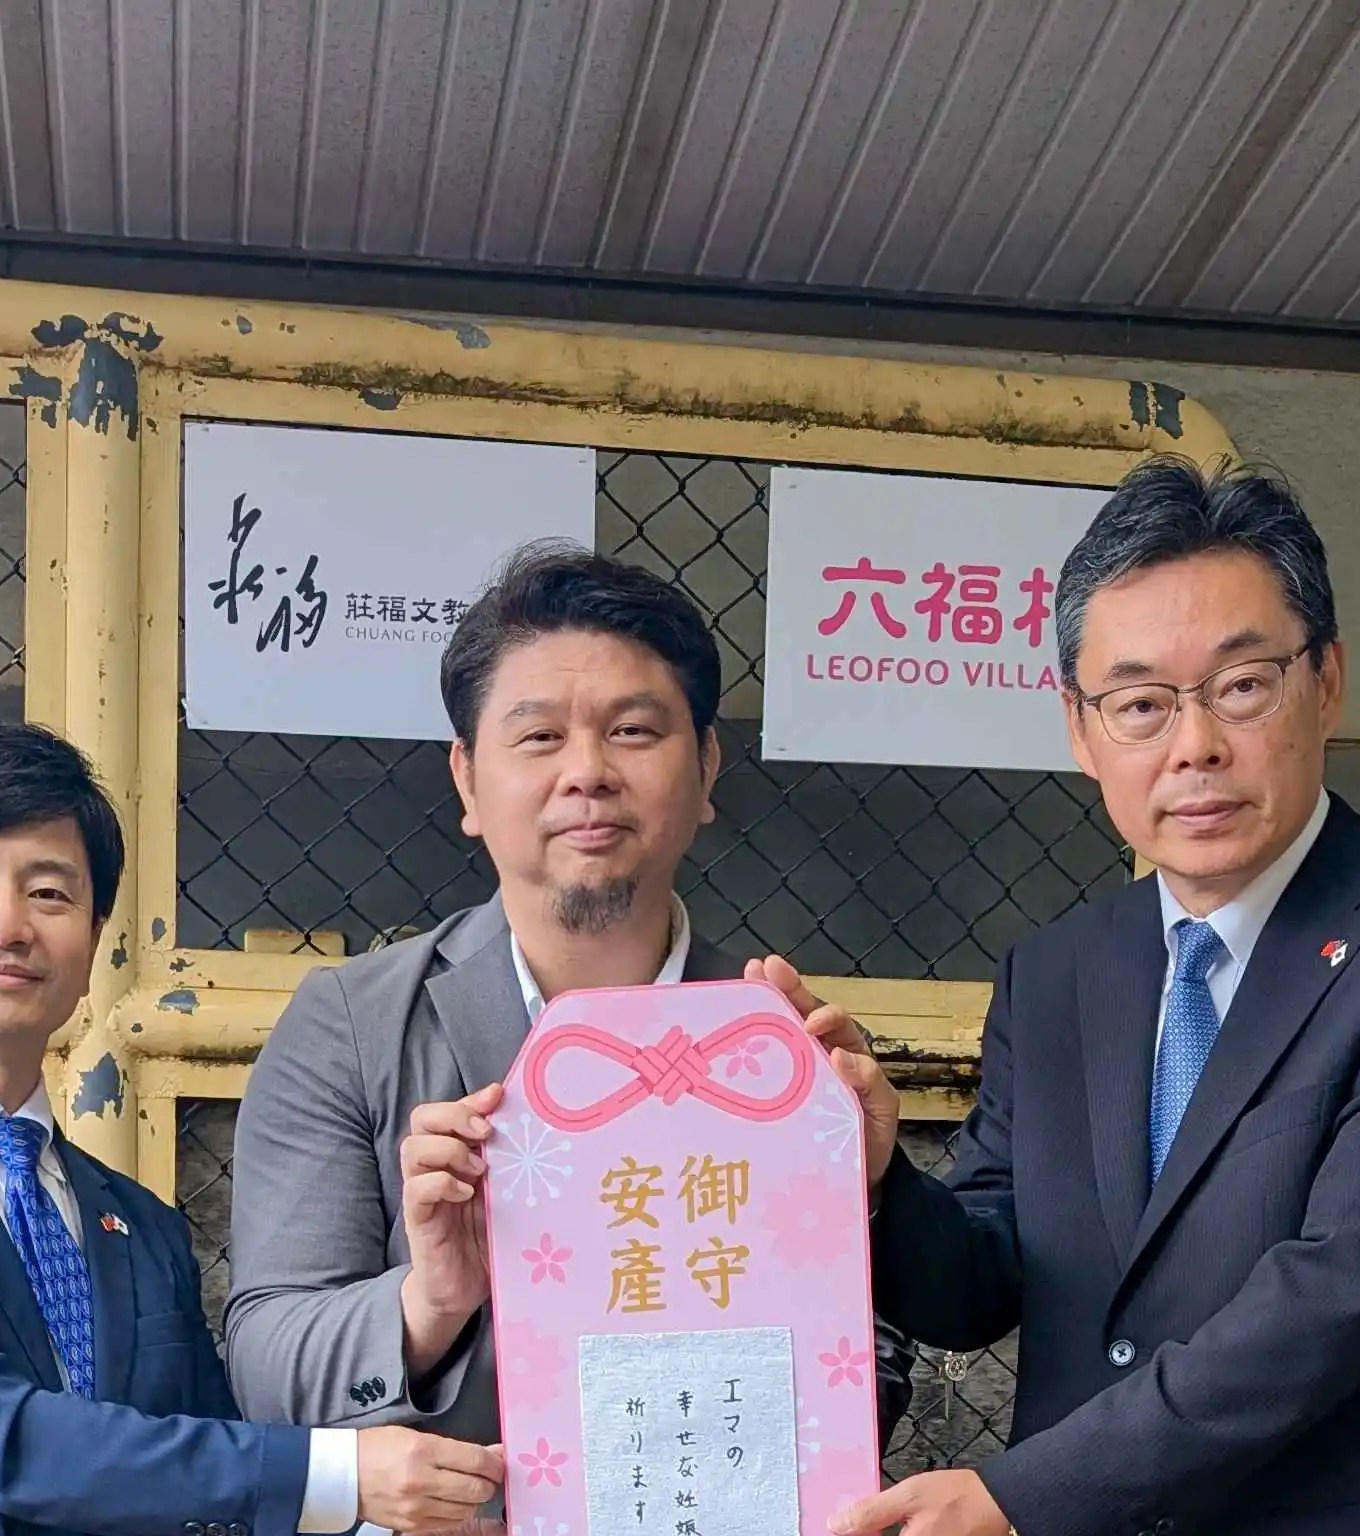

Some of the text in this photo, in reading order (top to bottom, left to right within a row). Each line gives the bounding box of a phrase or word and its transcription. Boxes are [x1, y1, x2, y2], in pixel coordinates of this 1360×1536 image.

[344, 625, 415, 643] CHUANG
[807, 653, 950, 687] LEOFOO
[676, 1153, 750, 1310] 御守
